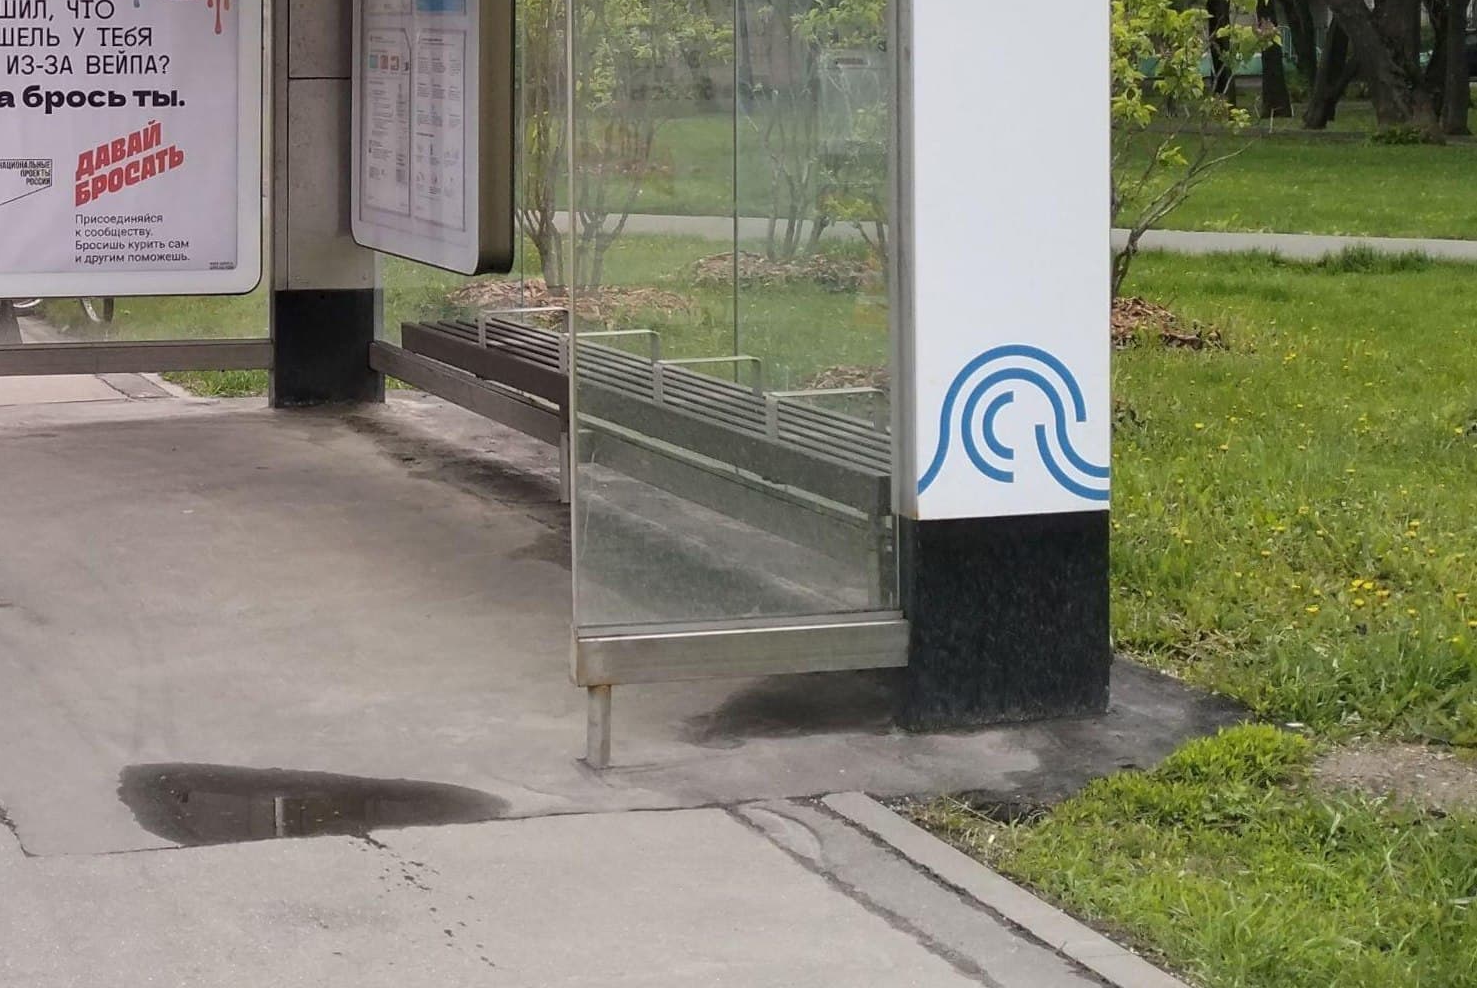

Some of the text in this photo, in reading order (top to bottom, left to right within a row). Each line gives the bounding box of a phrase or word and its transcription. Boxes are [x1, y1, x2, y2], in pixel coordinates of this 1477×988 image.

[72, 27, 85, 47] У
[6, 54, 74, 75] ИЗ-ЗА
[86, 50, 170, 75] ВЕЙПА?
[22, 84, 127, 114] брось
[132, 90, 186, 107] ты.
[75, 119, 162, 182] ДАВАЙ
[75, 144, 184, 207] БРОСАТЬ
[75, 213, 163, 225] Присоединяйся
[75, 226, 153, 238] к сообществу.
[75, 239, 189, 252] Бросишь курить сам
[75, 253, 190, 265] и другим поможешь.
